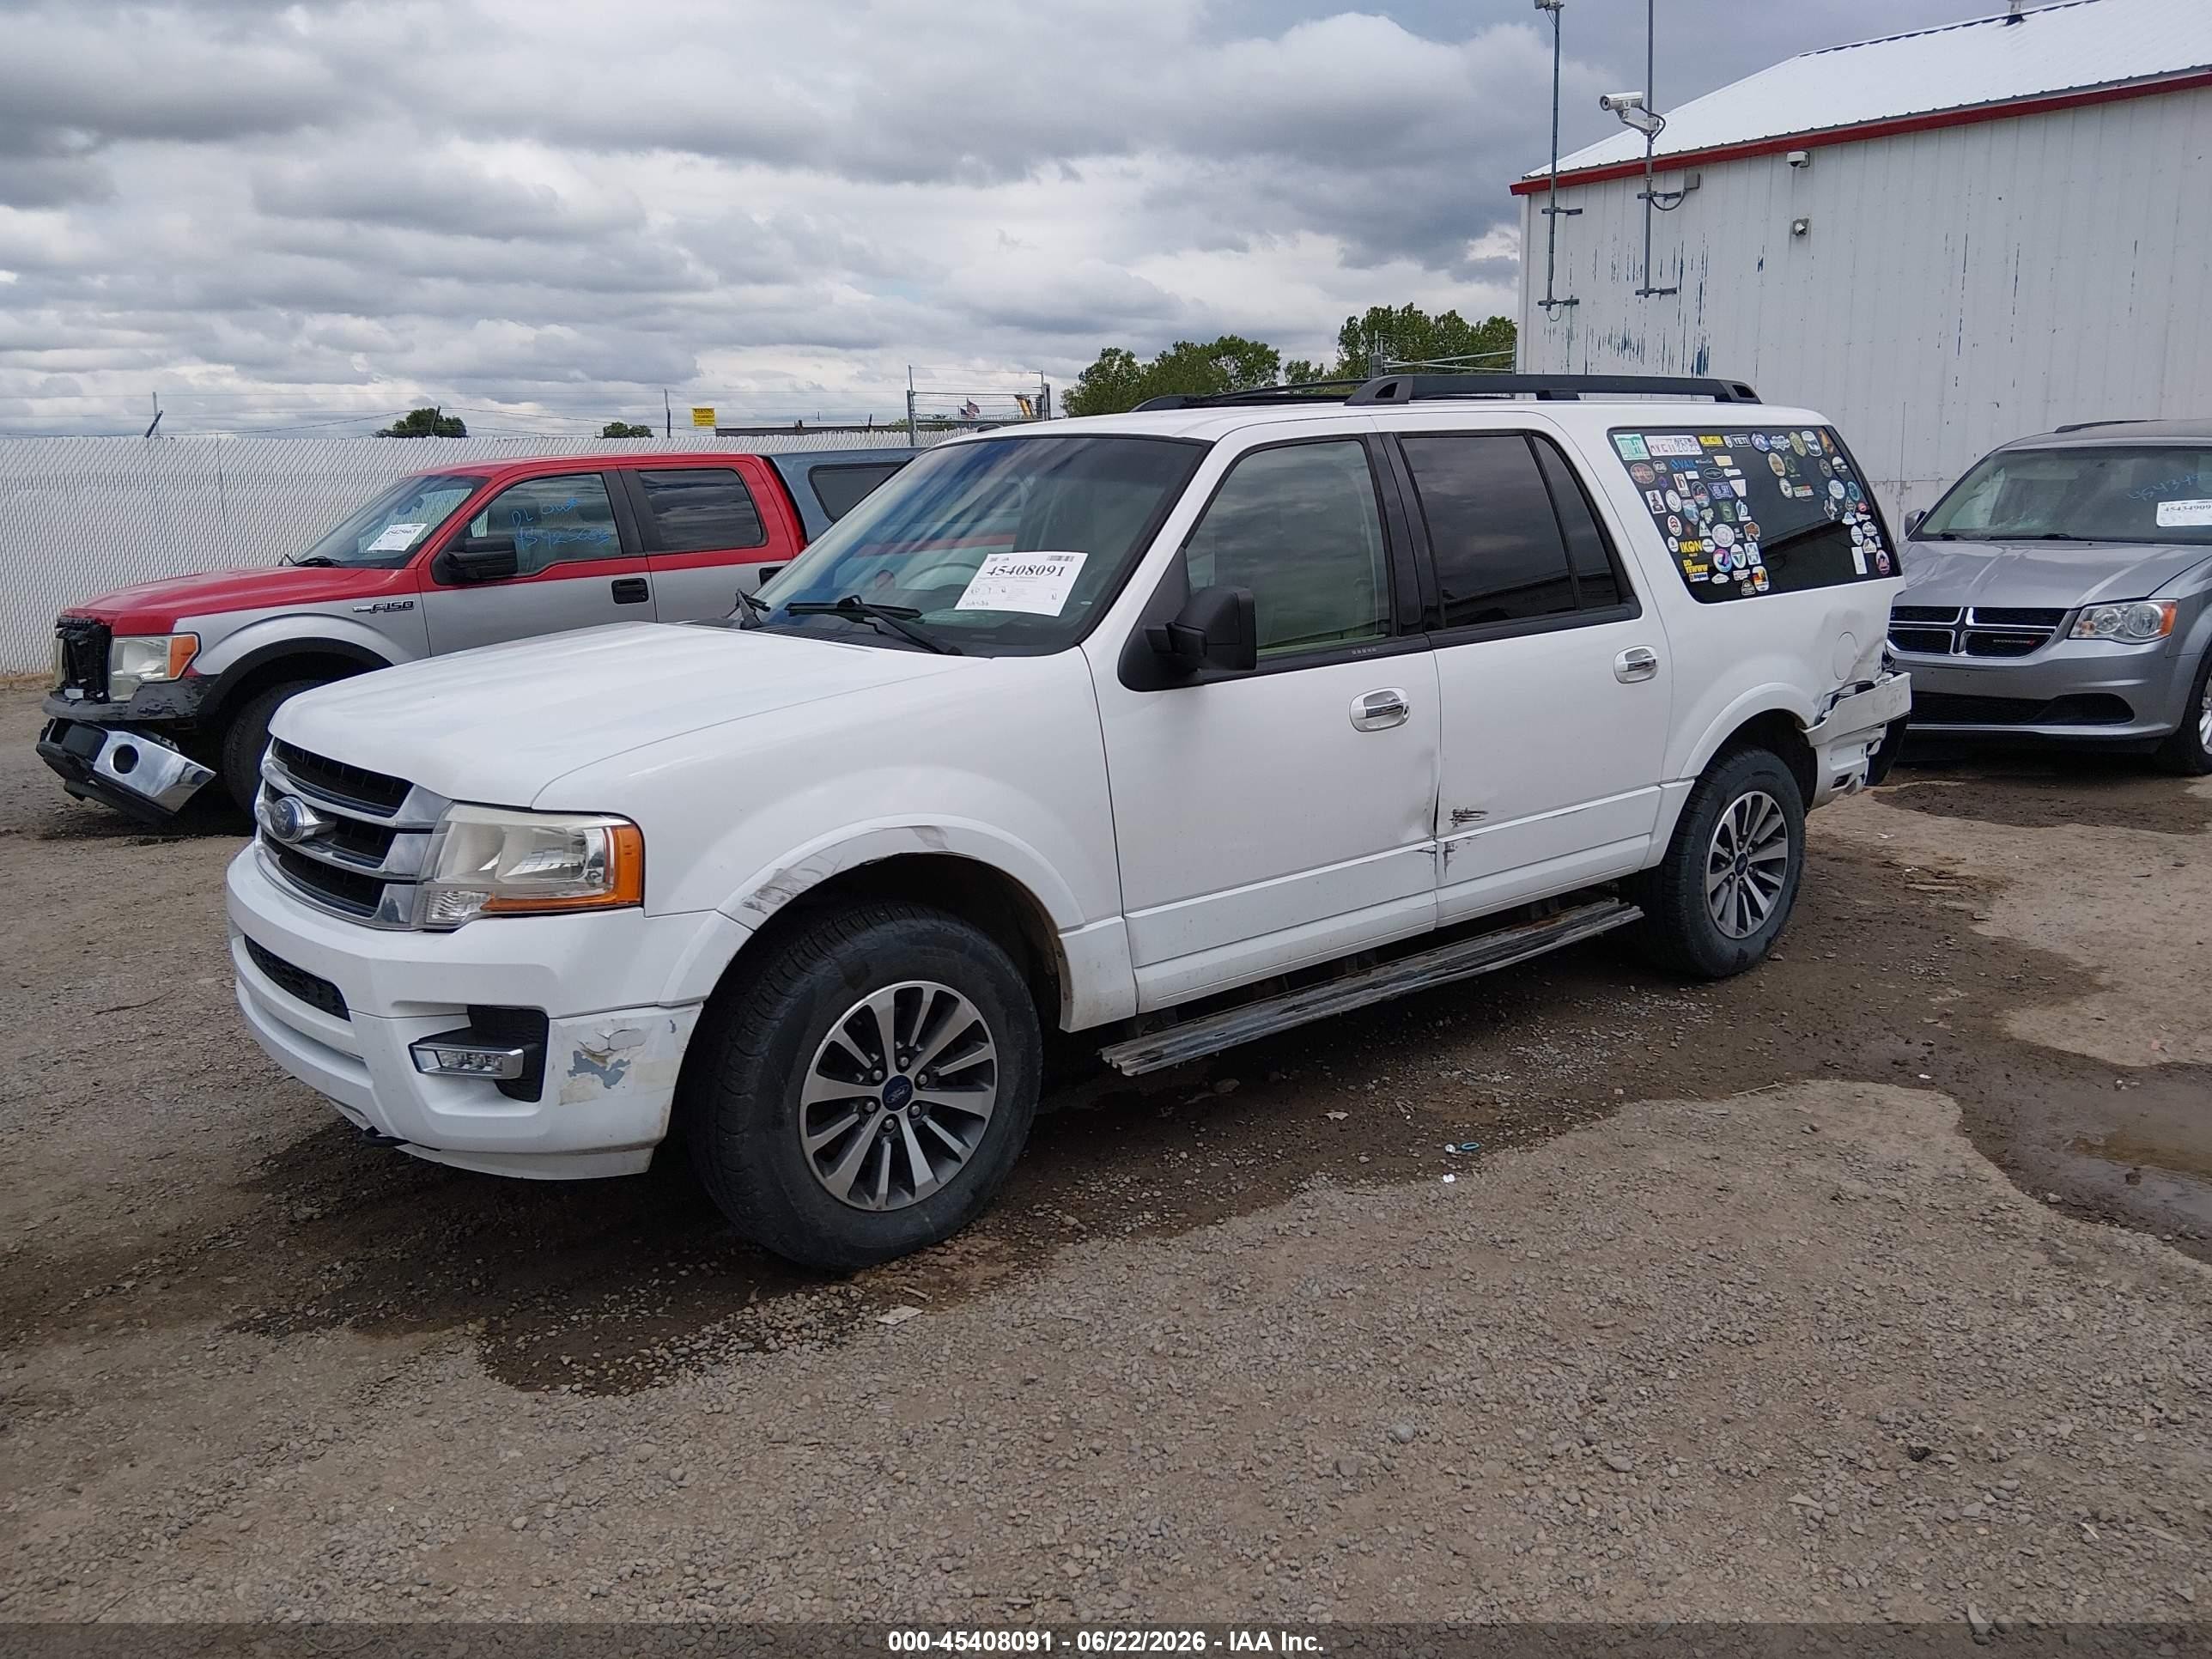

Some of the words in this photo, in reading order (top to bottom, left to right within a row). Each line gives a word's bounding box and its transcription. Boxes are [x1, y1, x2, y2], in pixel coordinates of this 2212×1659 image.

[1733, 436, 1750, 445] YETI
[1678, 459, 1698, 469] VAIL
[1680, 540, 1703, 553] IKON
[987, 564, 1066, 577] 45408091
[370, 599, 414, 614] F-150
